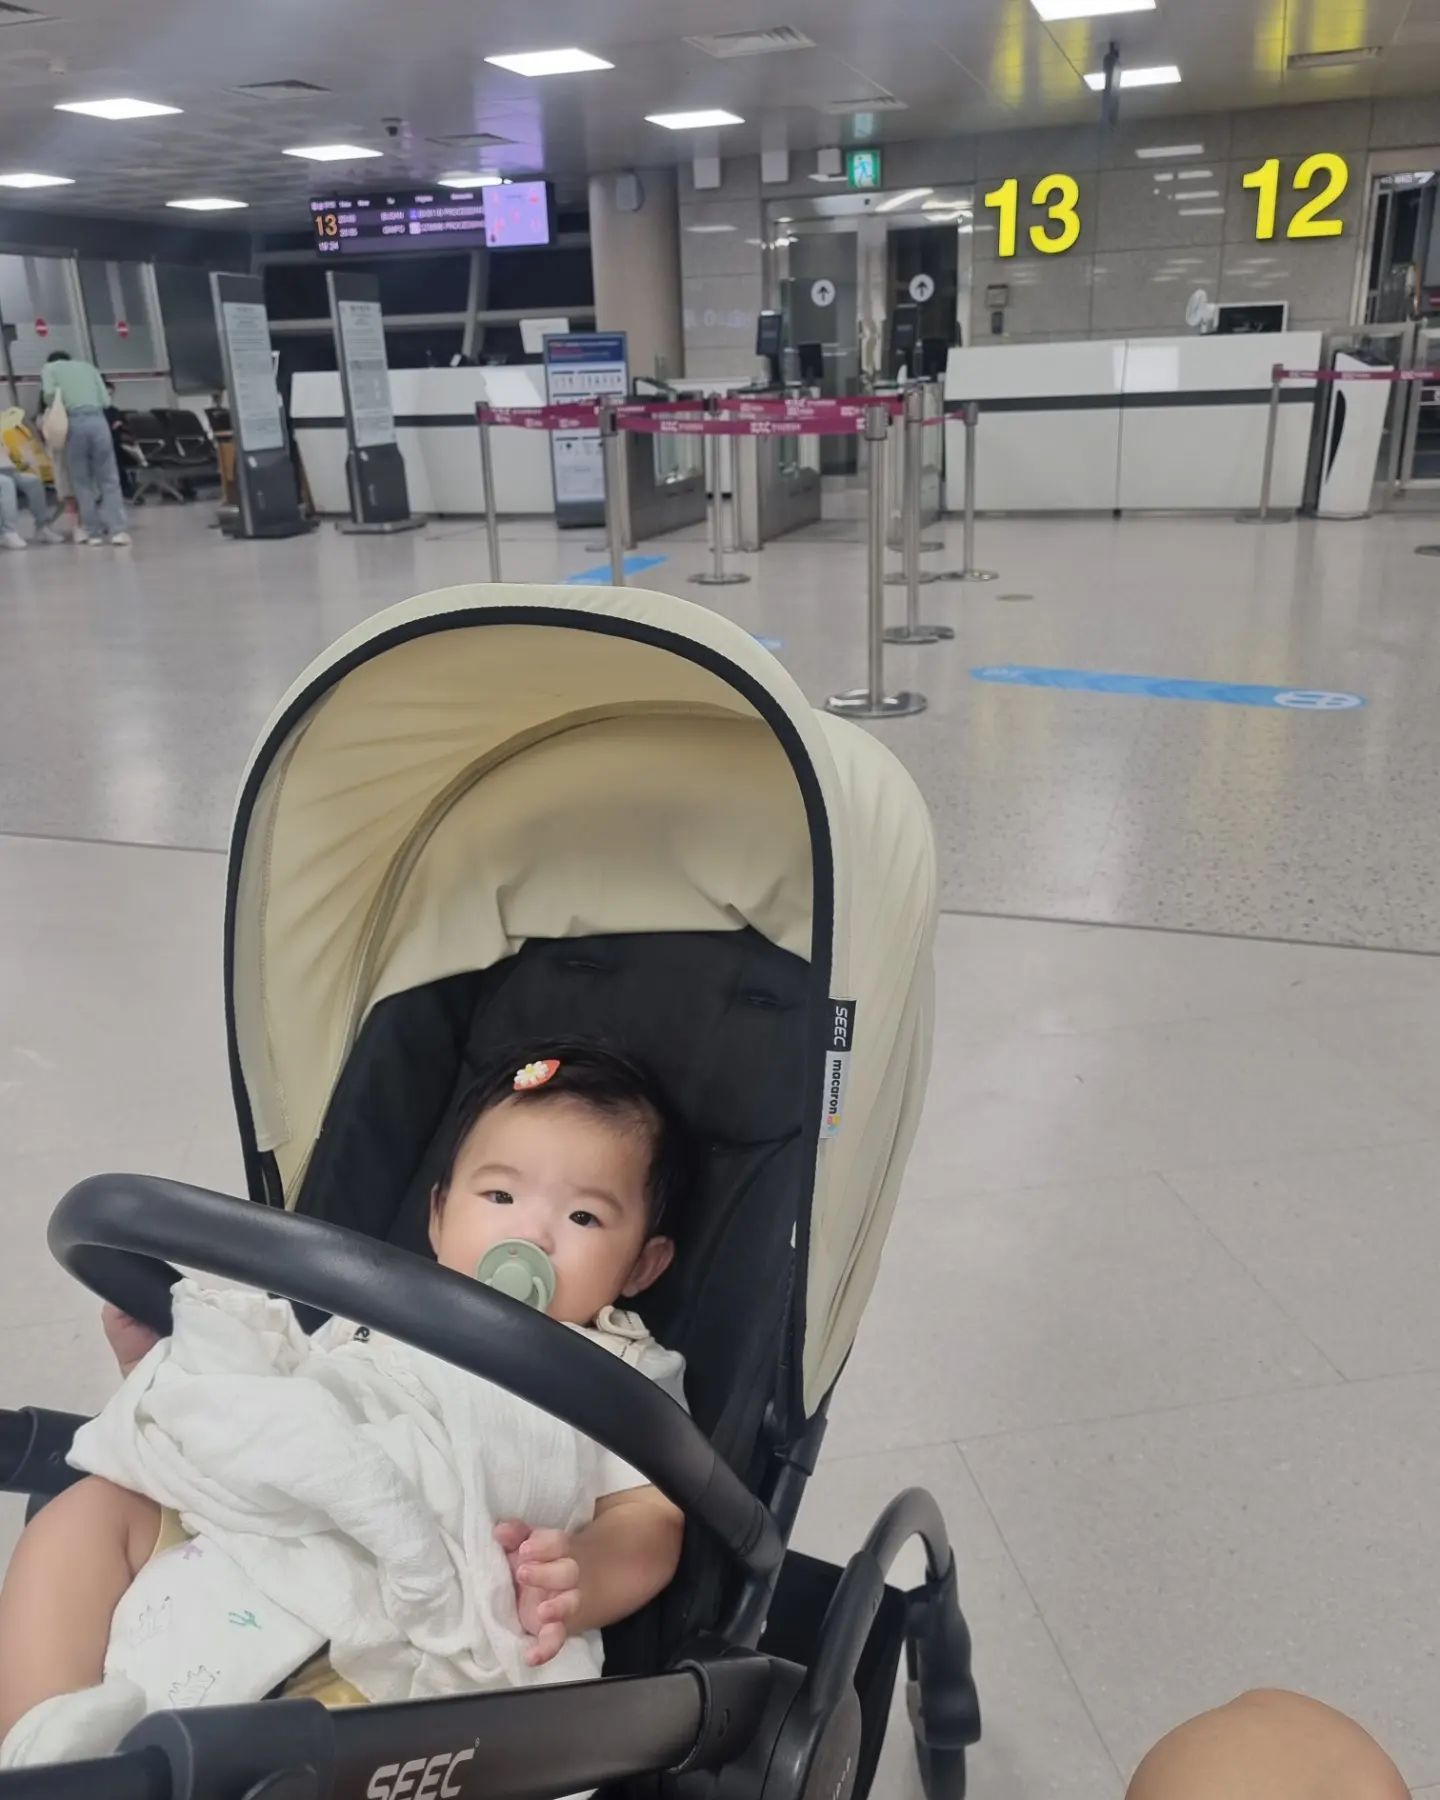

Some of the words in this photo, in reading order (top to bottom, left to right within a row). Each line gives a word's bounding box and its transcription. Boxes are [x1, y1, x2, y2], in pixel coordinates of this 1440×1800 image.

[984, 173, 1081, 257] 13
[1243, 152, 1349, 240] 12
[315, 213, 338, 237] 13
[833, 1005, 848, 1048] SEEC
[828, 1059, 842, 1115] macaron
[366, 1748, 475, 1800] SEEC
